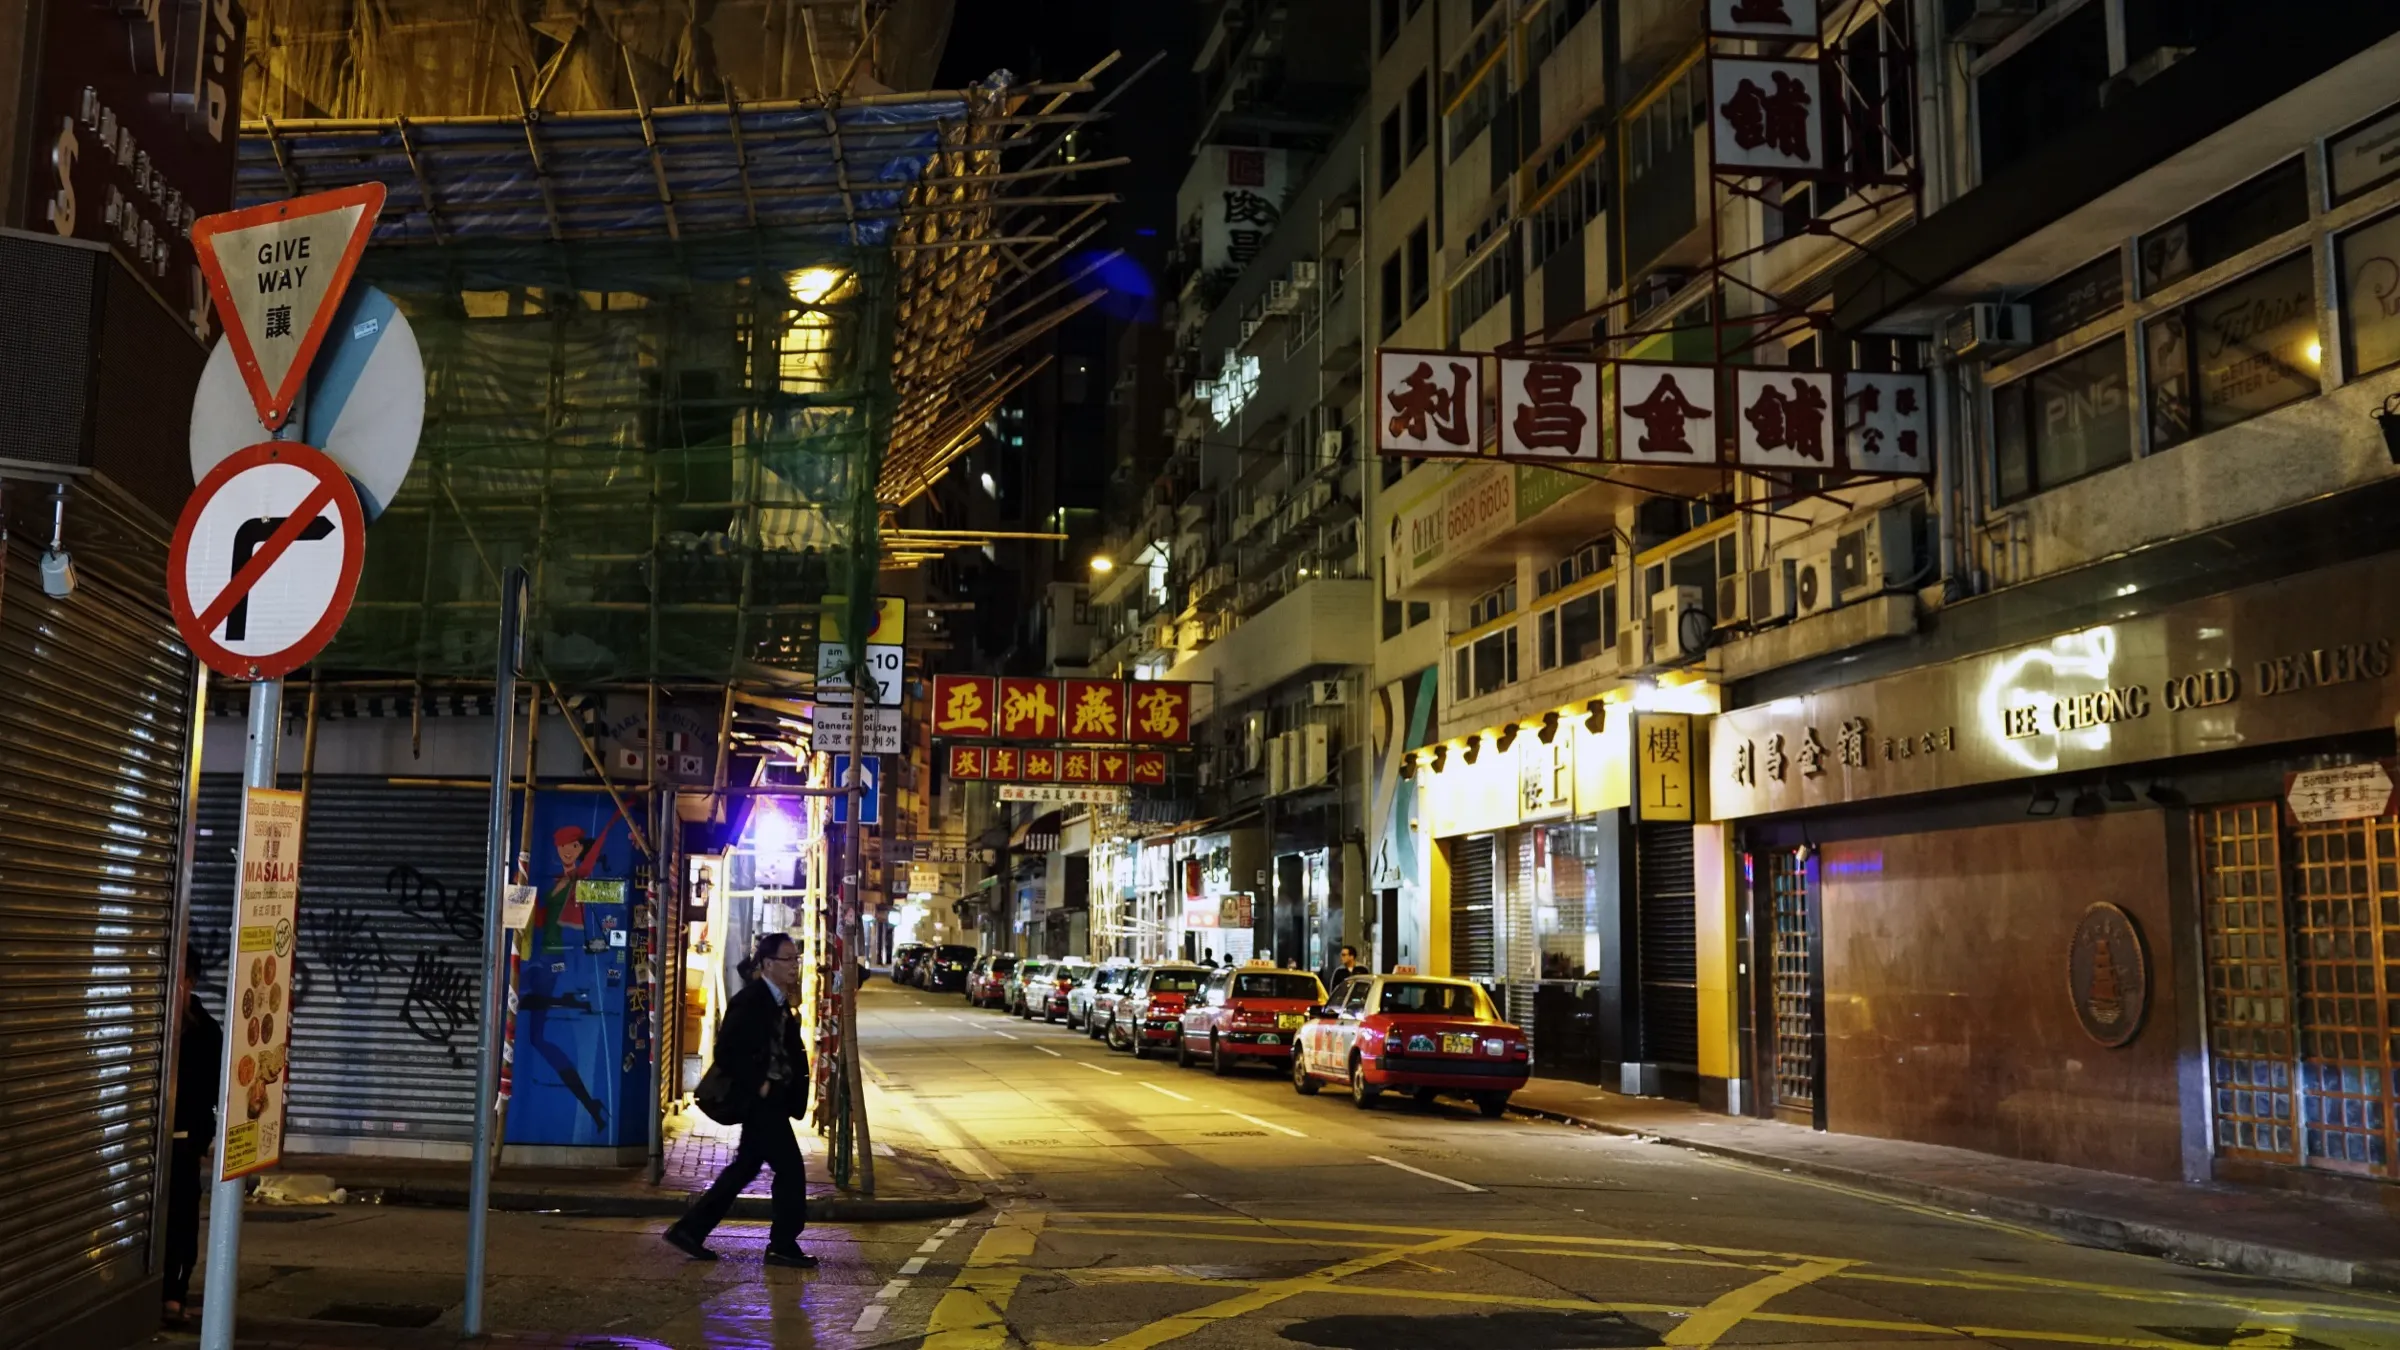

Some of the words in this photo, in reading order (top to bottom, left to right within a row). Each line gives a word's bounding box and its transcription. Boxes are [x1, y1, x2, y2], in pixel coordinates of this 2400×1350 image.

[258, 236, 311, 265] GIVE
[258, 265, 308, 294] WAY
[265, 304, 292, 340] 讓
[2045, 372, 2122, 437] PING
[827, 647, 843, 656] am
[2000, 703, 2040, 740] LEE
[2053, 683, 2150, 732] CHEONG
[2161, 667, 2241, 712] GOLD
[2253, 637, 2392, 698] DEALERS
[864, 723, 897, 734] olidays
[1647, 725, 1683, 809] 樓上
[245, 861, 295, 883] MASALA
[1396, 965, 1416, 975] TAXI
